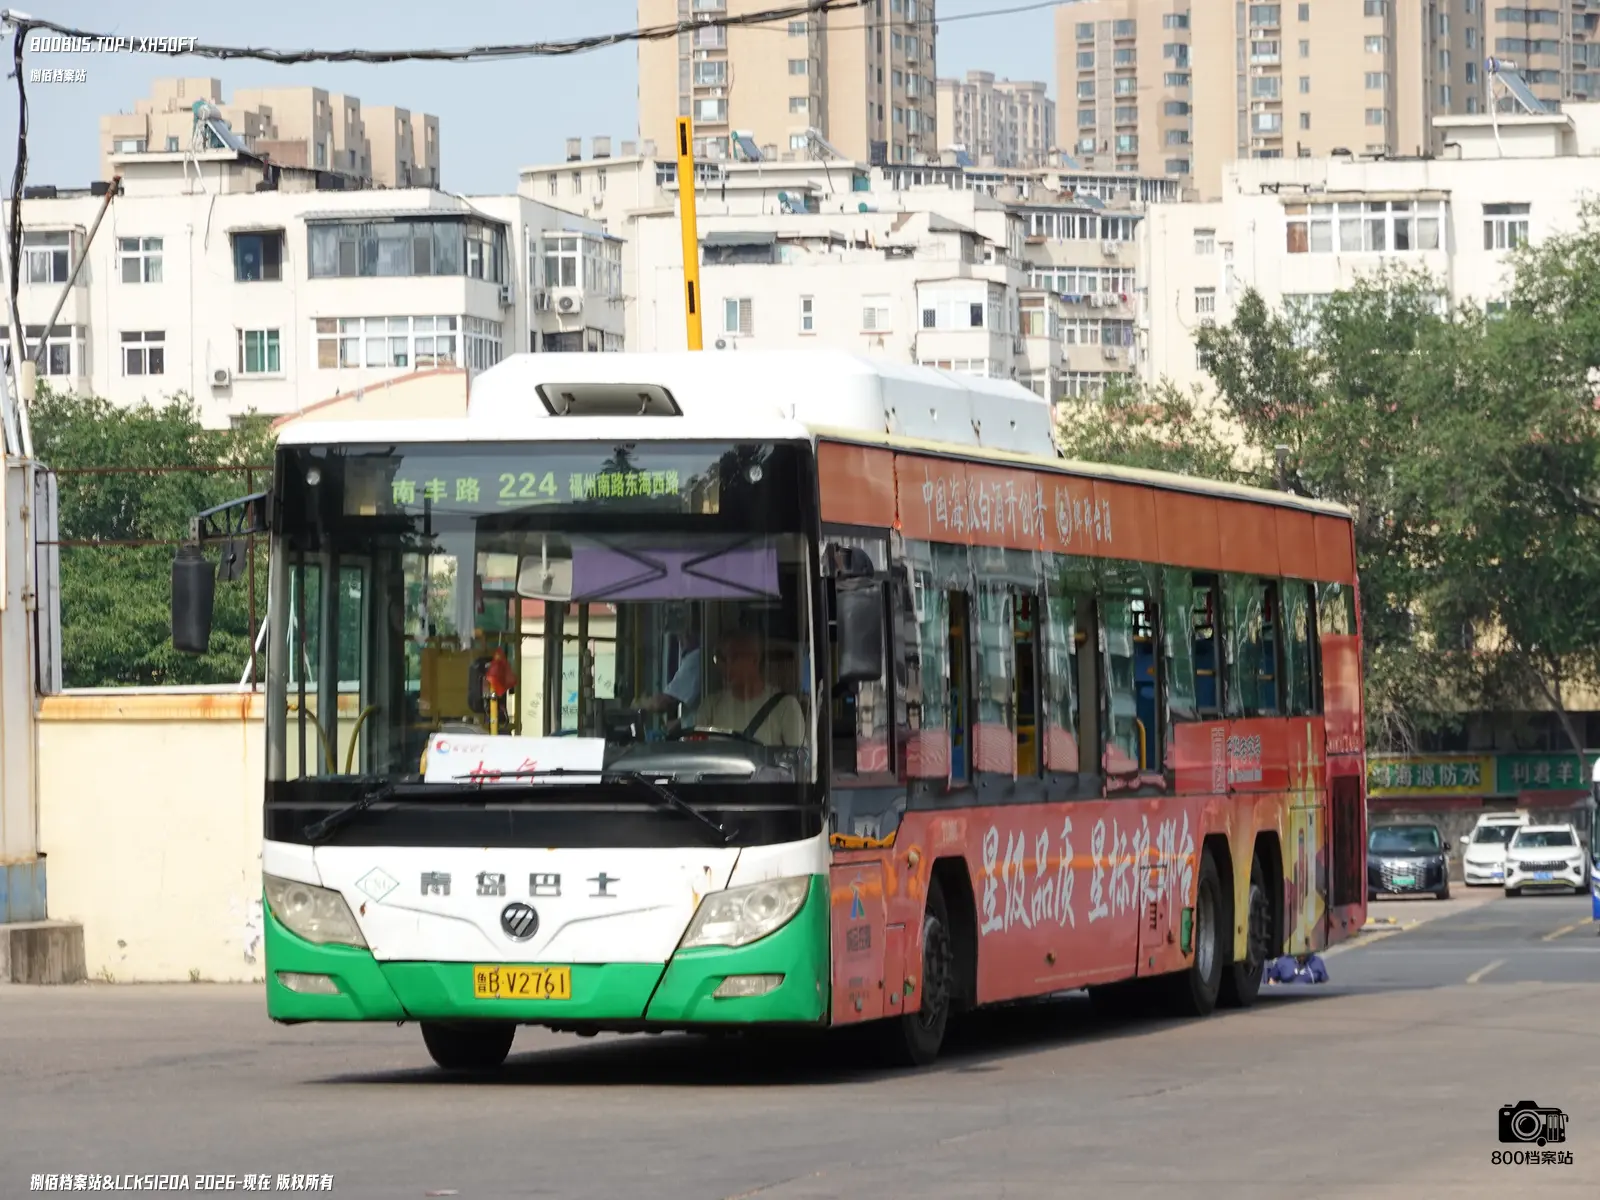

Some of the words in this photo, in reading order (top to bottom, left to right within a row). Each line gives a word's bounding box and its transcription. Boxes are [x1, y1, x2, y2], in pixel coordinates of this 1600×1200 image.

[391, 477, 480, 504] 南丰路
[499, 471, 558, 499] 224
[568, 470, 680, 498] 福州南路东海西路
[981, 815, 1076, 937] 星级品质
